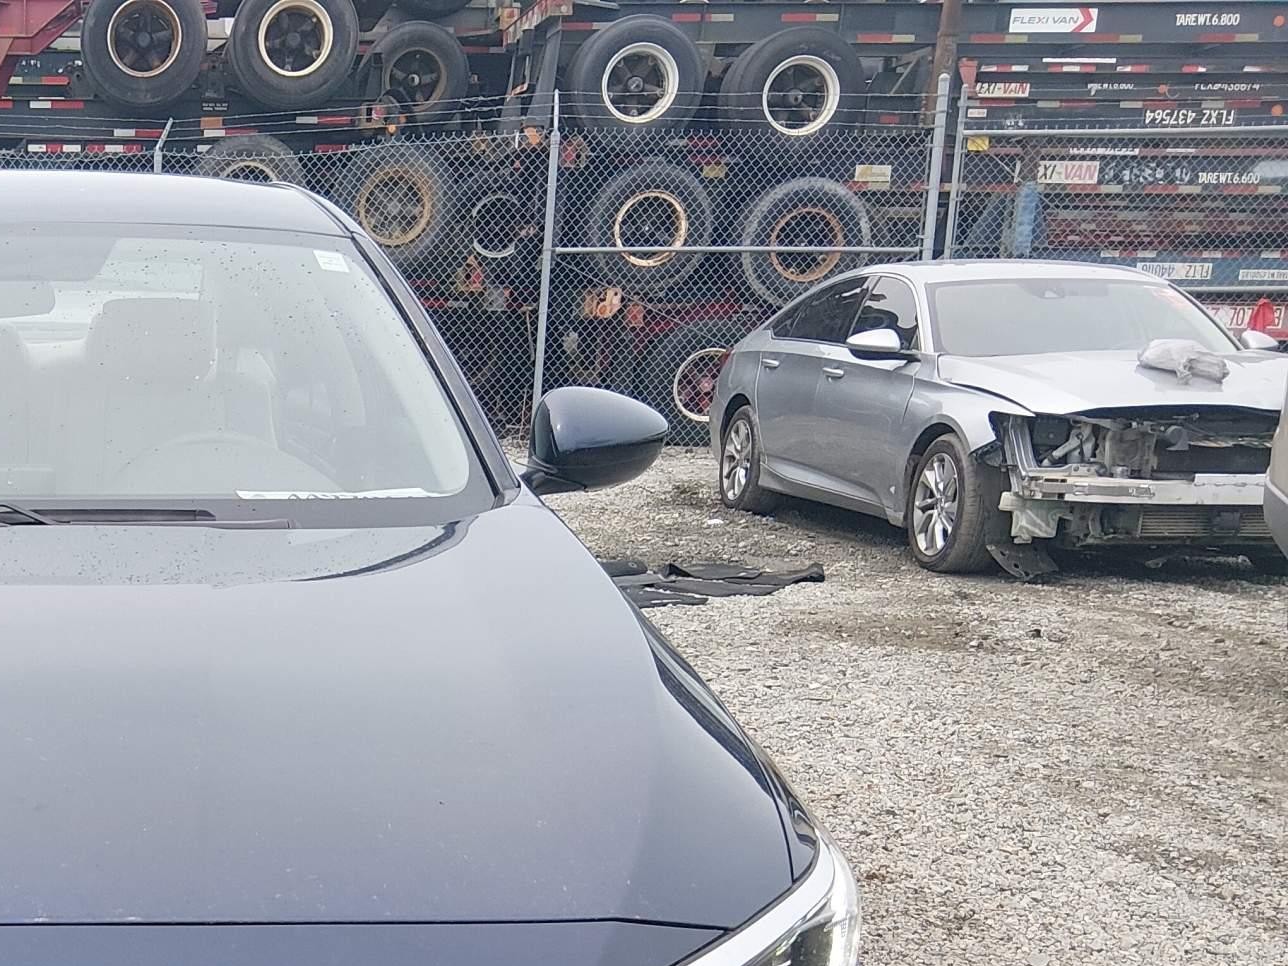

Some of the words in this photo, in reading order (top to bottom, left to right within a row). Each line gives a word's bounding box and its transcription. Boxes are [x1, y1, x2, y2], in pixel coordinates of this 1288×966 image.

[1012, 16, 1049, 25] FLEXI
[1052, 16, 1079, 25] VAN
[1145, 110, 1197, 125] 437564
[1200, 110, 1235, 125] FLXZ
[1185, 264, 1210, 278] FLTZ
